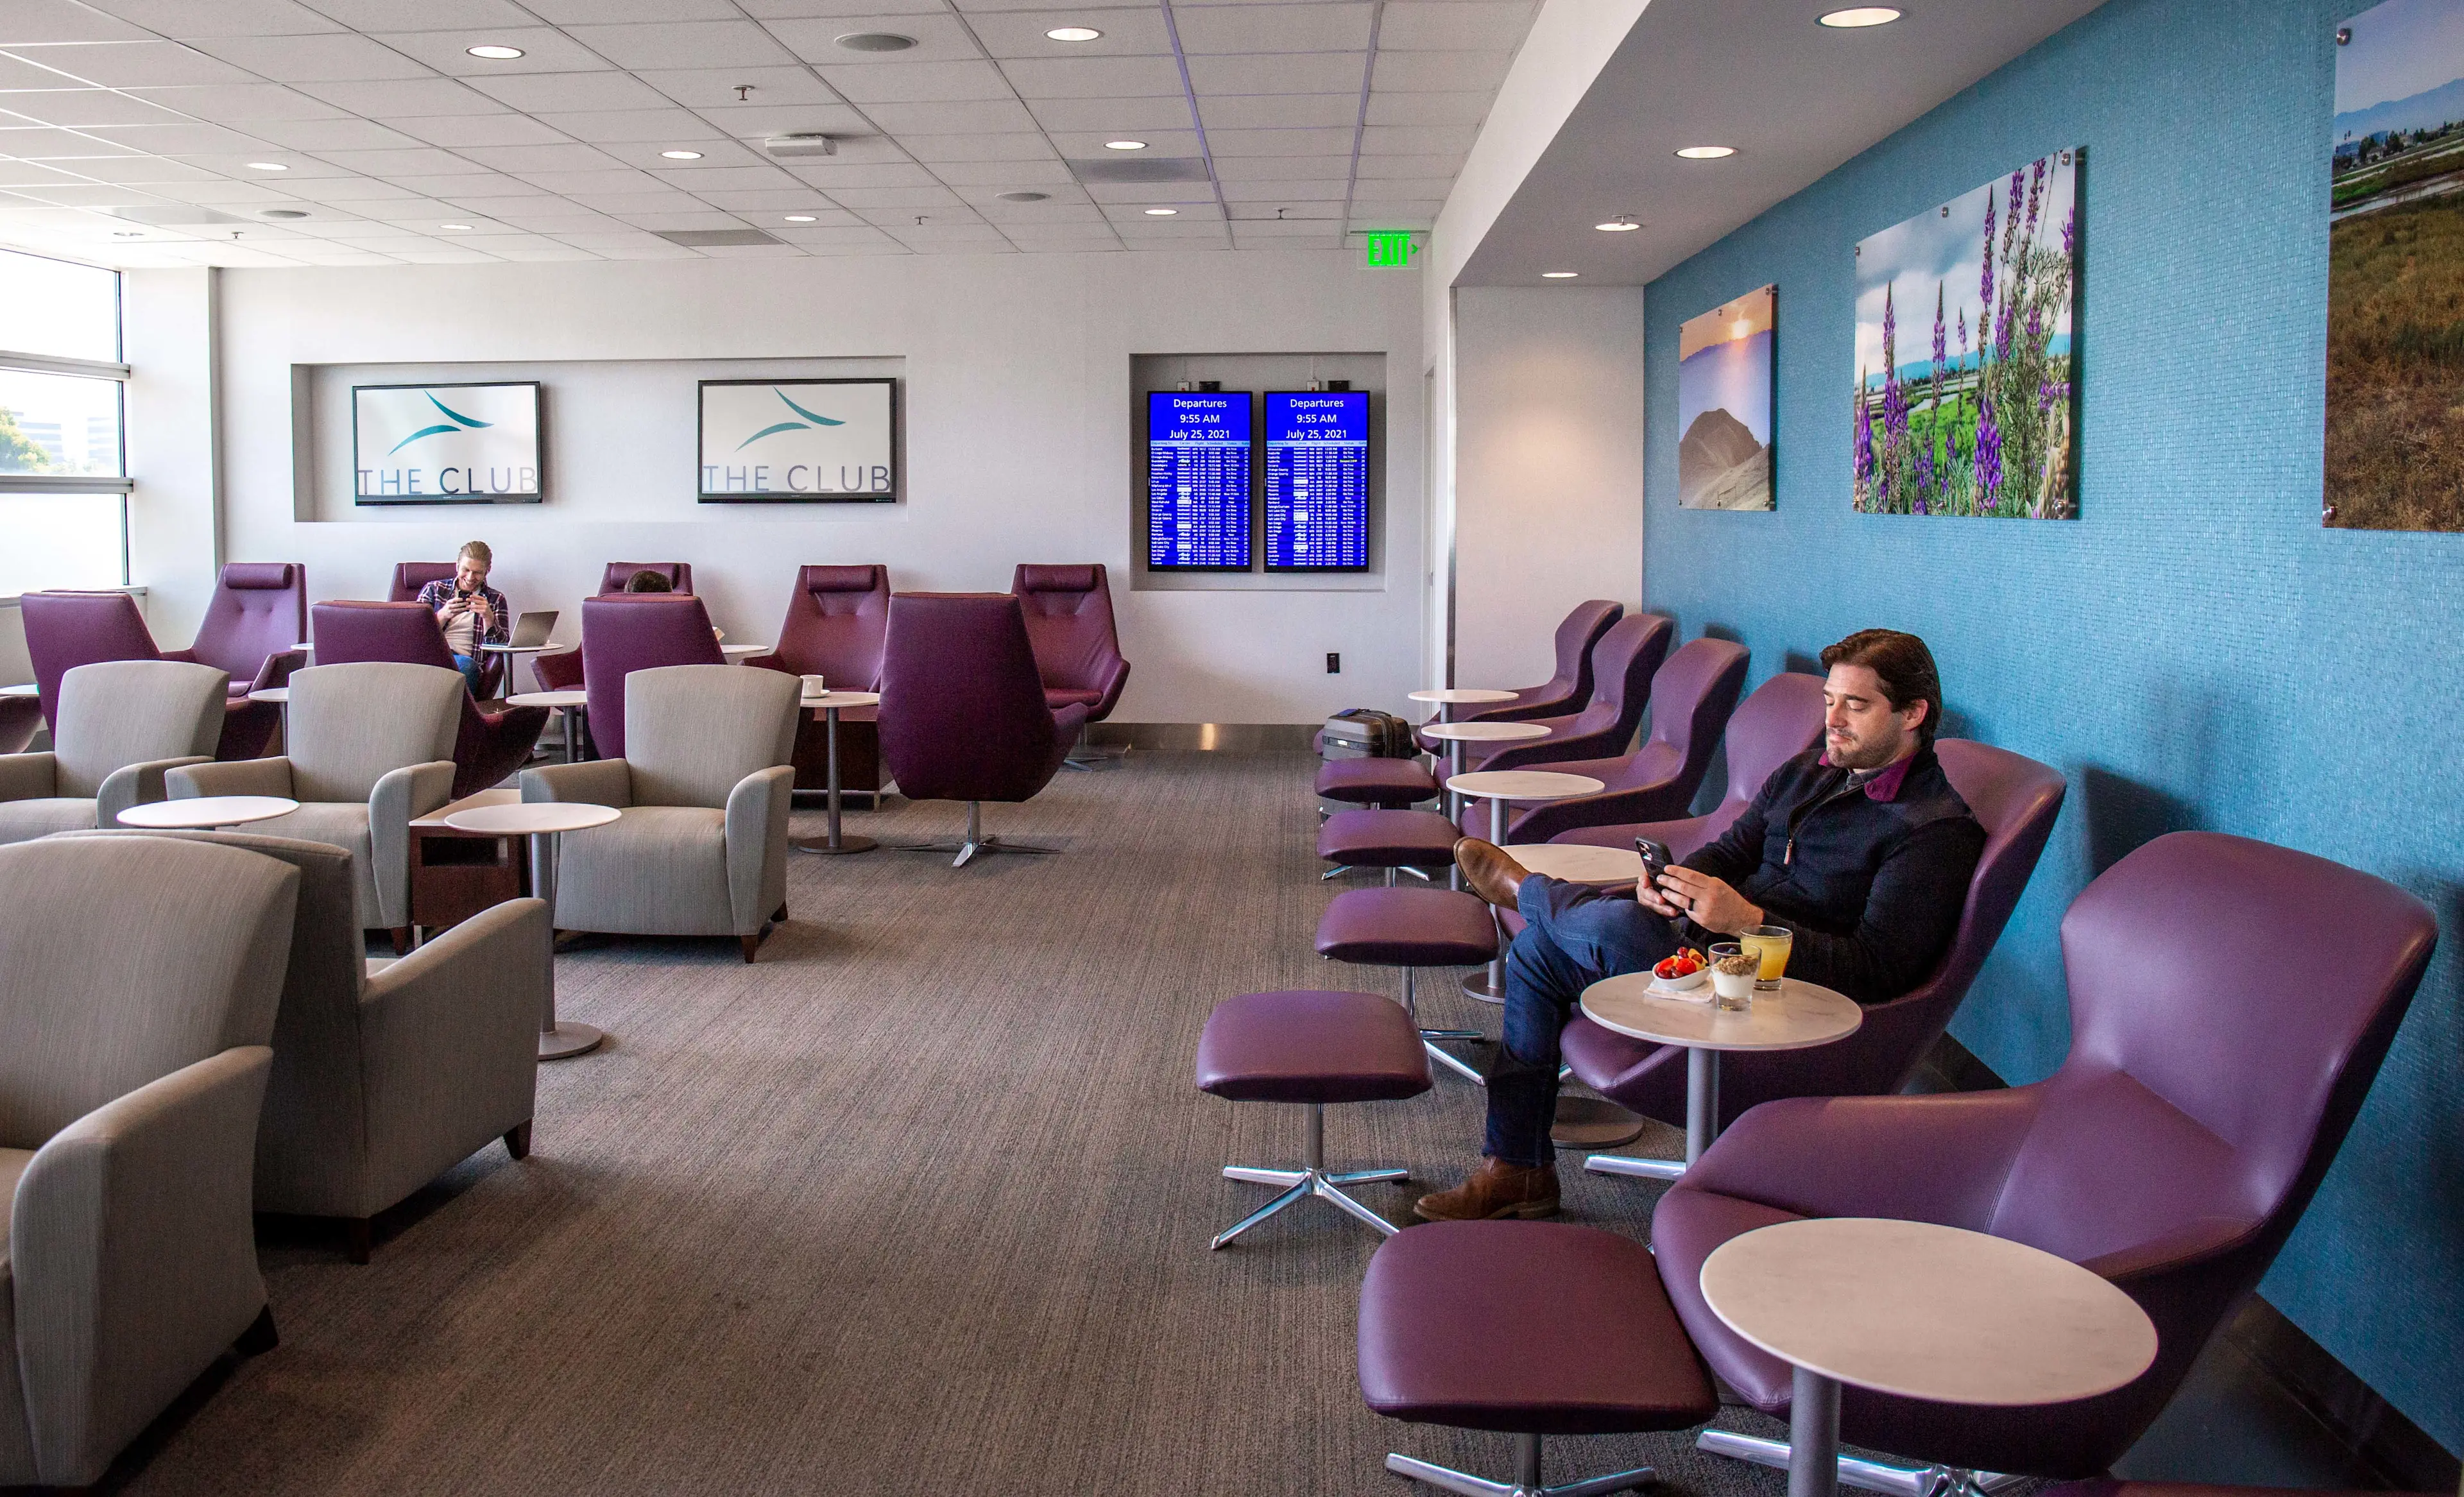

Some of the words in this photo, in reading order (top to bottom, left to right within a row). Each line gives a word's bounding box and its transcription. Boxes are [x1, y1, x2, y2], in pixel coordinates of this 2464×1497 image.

[1368, 234, 1410, 266] EXIT
[1174, 398, 1227, 410] Departures
[1290, 398, 1344, 410] Departures
[1179, 414, 1201, 423] 9:55
[1202, 414, 1220, 423] AM
[1296, 414, 1317, 423] 9:55
[1319, 414, 1337, 423] AM
[1169, 429, 1189, 440] July
[1190, 429, 1205, 440] 25,
[1207, 429, 1230, 438] 2021
[1285, 429, 1305, 440] July
[1307, 429, 1322, 440] 25,
[1324, 429, 1347, 438] 2021
[358, 468, 422, 495] THE
[440, 467, 538, 493] CLUB
[703, 465, 769, 492] THE
[787, 465, 891, 492] CLUB
